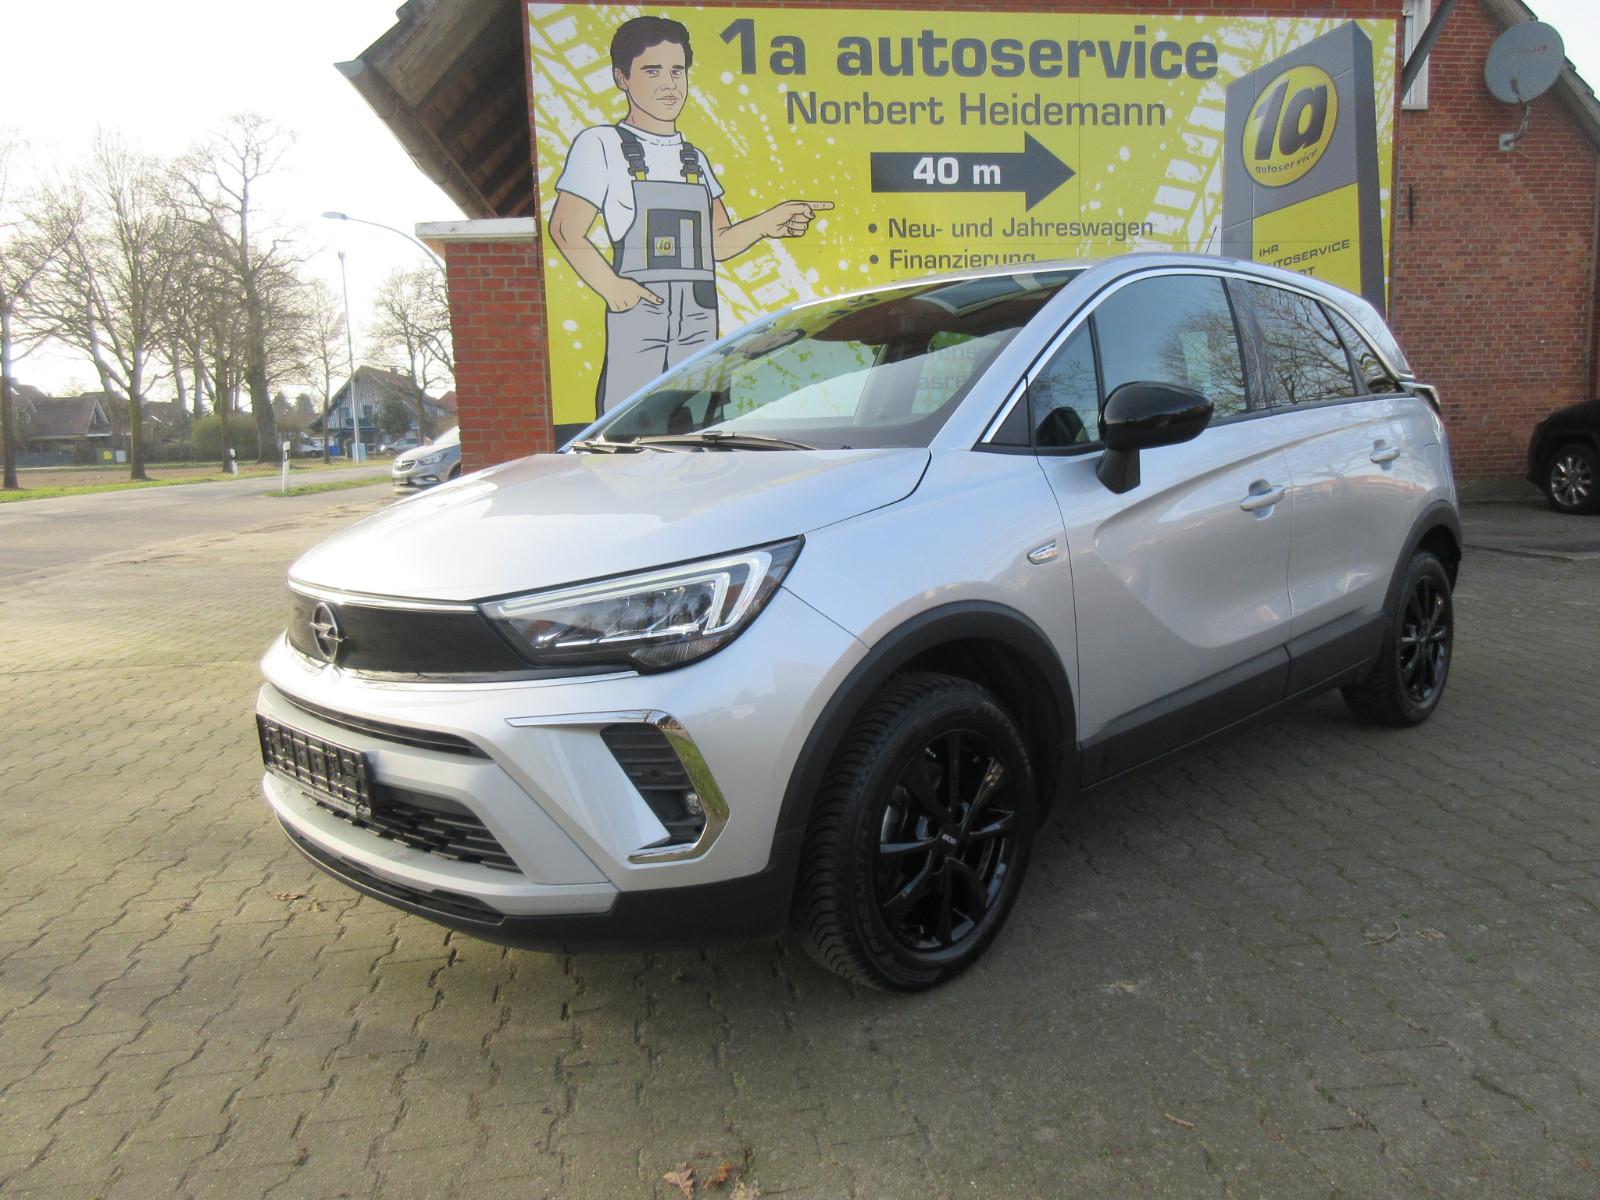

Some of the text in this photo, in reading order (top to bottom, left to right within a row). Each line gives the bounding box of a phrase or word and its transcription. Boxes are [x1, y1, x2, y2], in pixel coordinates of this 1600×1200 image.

[719, 18, 1219, 80] 1a autoservice
[786, 90, 1166, 127] Norbert Heidemann
[1254, 79, 1328, 160] 1a
[912, 156, 1001, 185] 40 m
[888, 217, 1153, 242] Neu- und Jahreswagen
[1259, 244, 1279, 257] IHR
